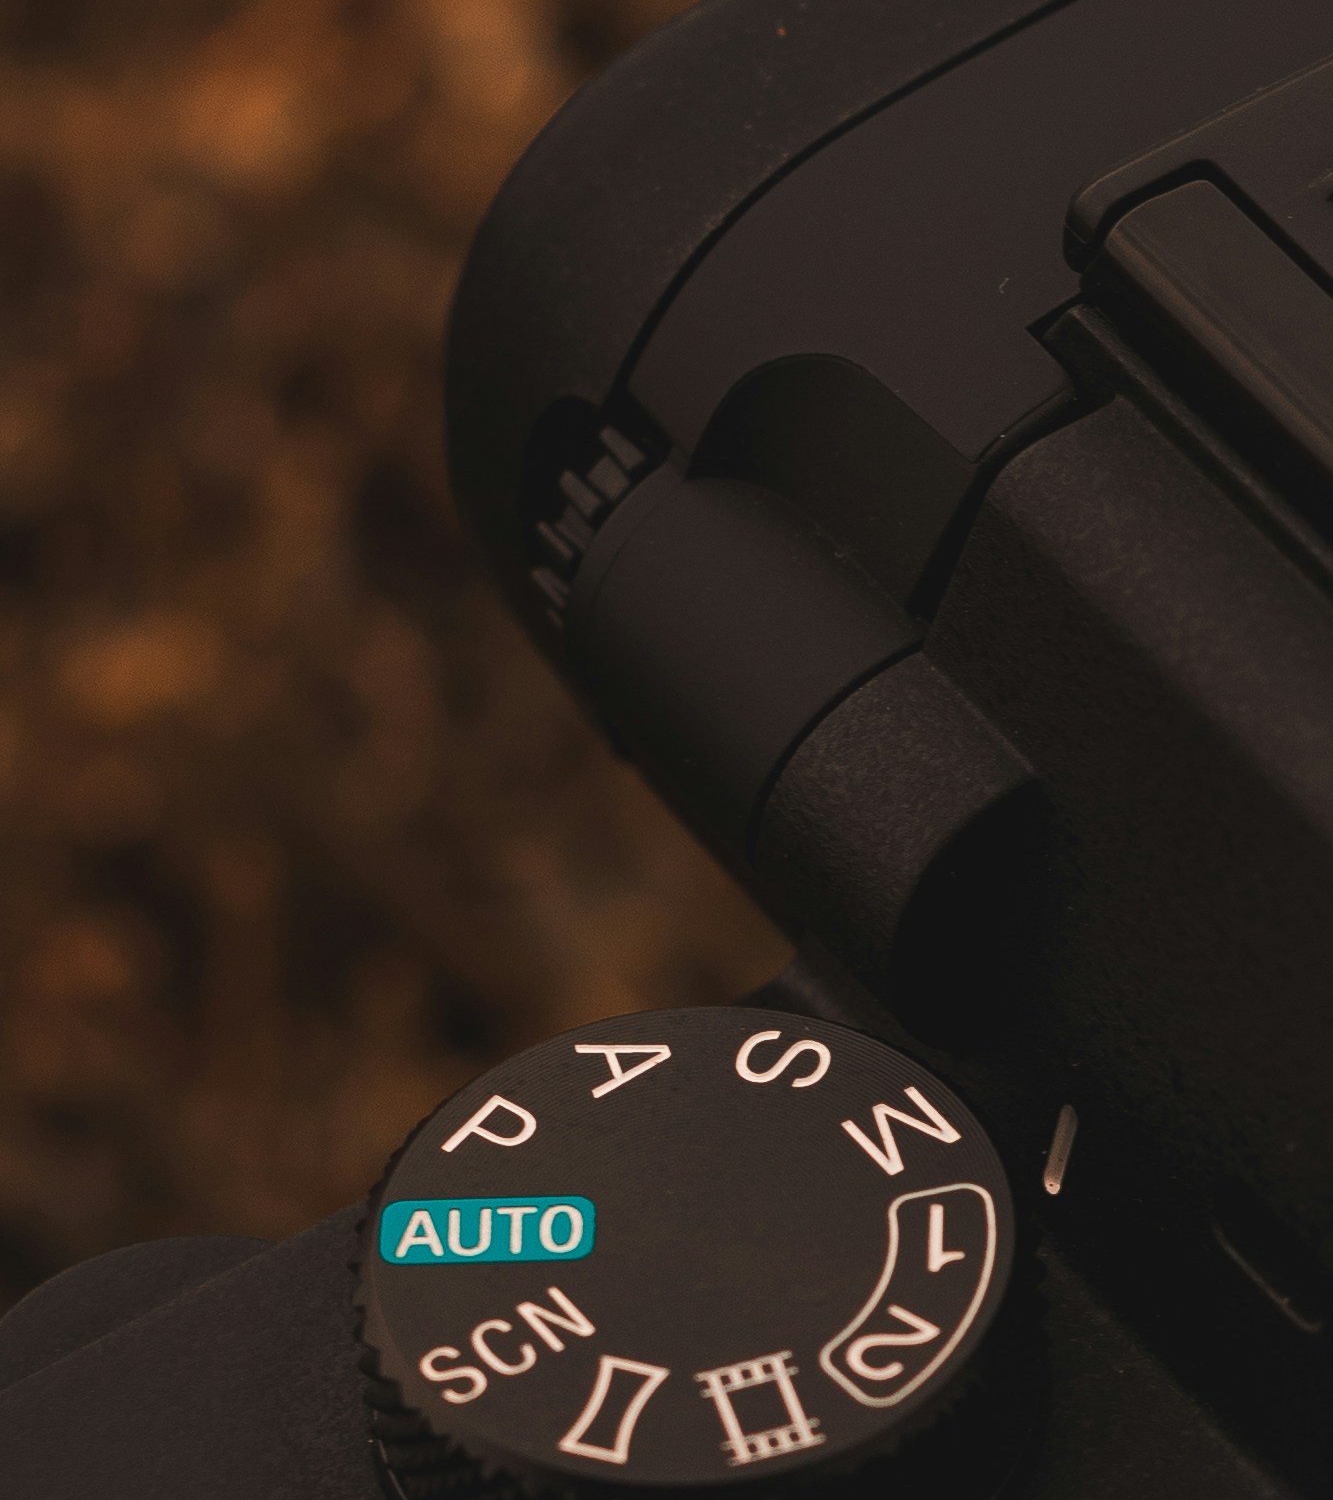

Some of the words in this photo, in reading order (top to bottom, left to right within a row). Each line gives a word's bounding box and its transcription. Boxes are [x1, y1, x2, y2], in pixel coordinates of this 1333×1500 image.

[573, 1043, 672, 1099] A
[734, 1029, 832, 1088] S
[440, 1094, 538, 1153] P
[839, 1085, 962, 1176] M
[395, 1203, 585, 1258] AUTO
[926, 1203, 966, 1273] 1
[418, 1286, 596, 1404] SCN
[845, 1304, 941, 1381] 2
